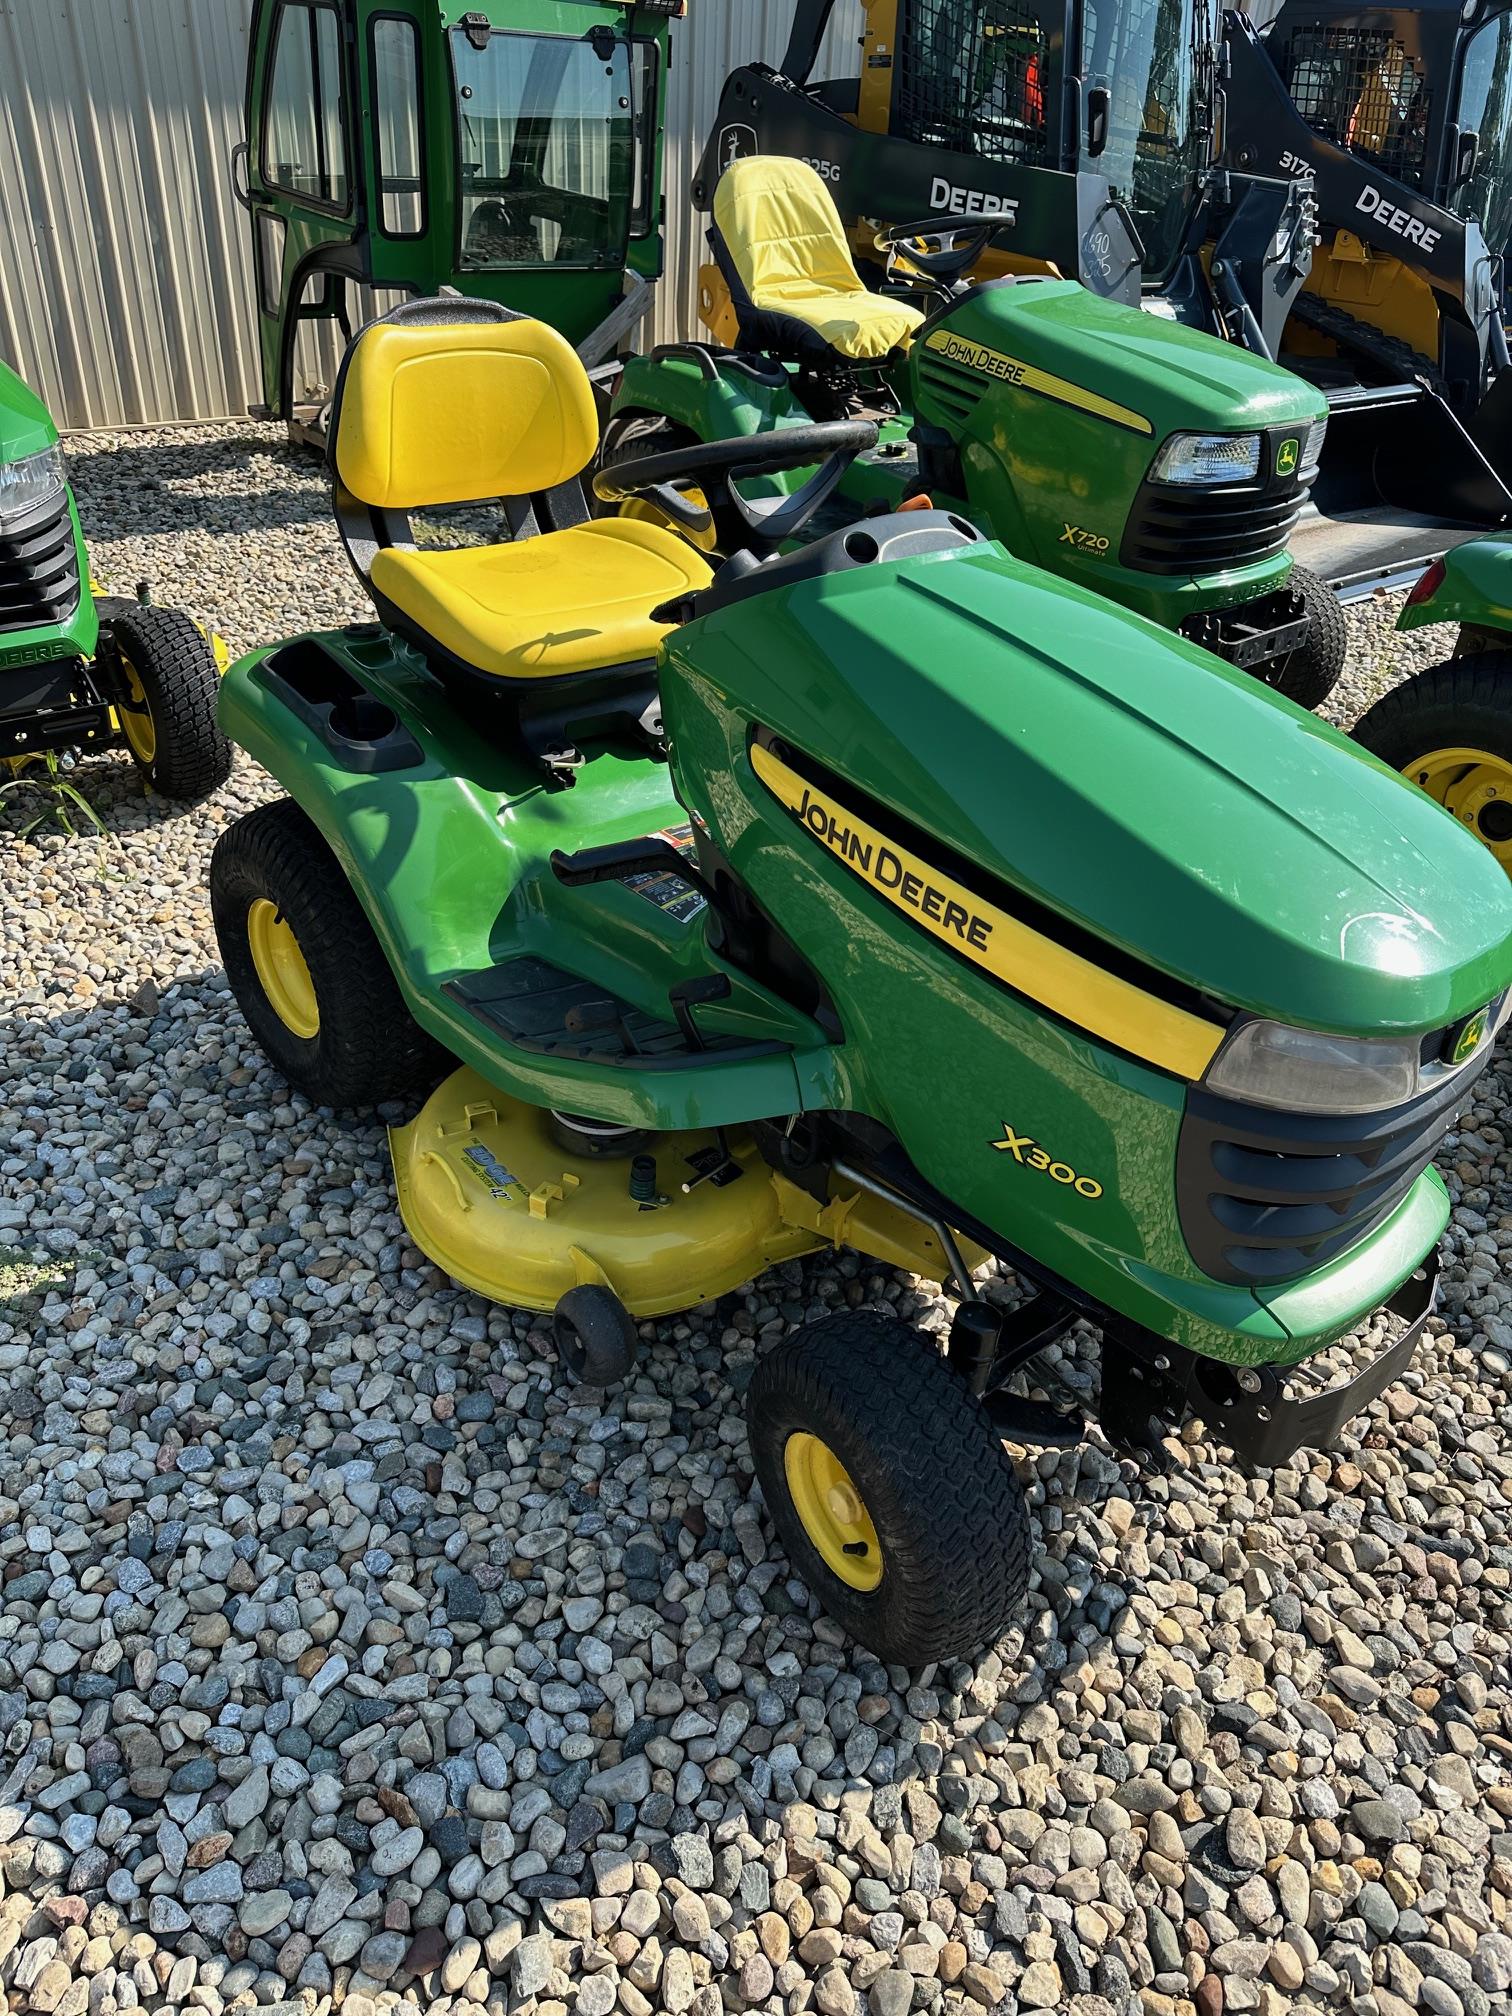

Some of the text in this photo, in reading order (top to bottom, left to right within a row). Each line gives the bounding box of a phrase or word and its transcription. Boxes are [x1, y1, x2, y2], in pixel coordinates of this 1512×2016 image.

[801, 156, 841, 182] 25G
[1355, 184, 1442, 254] DEERE
[939, 336, 1026, 385] JOHN DEERE
[1058, 522, 1111, 550] X720
[1077, 543, 1106, 557] Ultimate
[791, 789, 873, 872] JOHN
[874, 846, 994, 953] DEERE
[463, 1144, 519, 1187] EDGE
[986, 1120, 1104, 1199] X300
[490, 1187, 513, 1201] 42"
